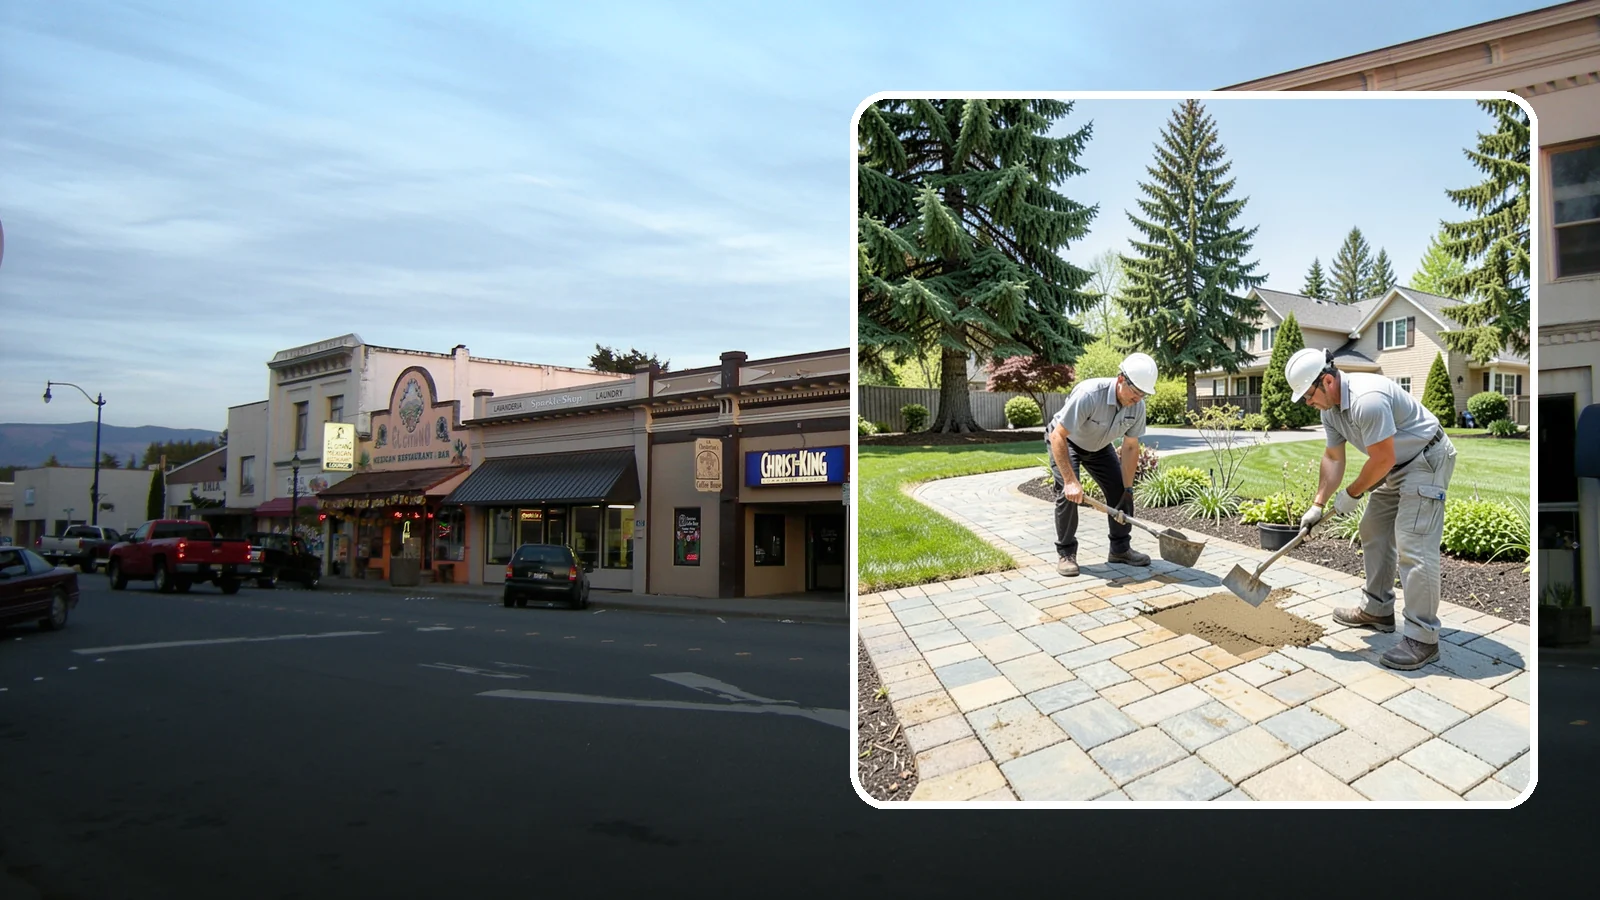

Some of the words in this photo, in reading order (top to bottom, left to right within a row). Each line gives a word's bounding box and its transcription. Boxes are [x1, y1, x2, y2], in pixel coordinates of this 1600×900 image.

[595, 389, 624, 400] LAUNDRY
[493, 402, 523, 413] LAVANDERIA
[530, 396, 560, 409] Sparkle
[562, 395, 582, 405] Shop
[374, 455, 396, 464] MEXICAN
[398, 451, 433, 462] RESTAURANT
[438, 450, 450, 459] BAR
[761, 452, 797, 478] CHRIST
[799, 450, 827, 476] KING
